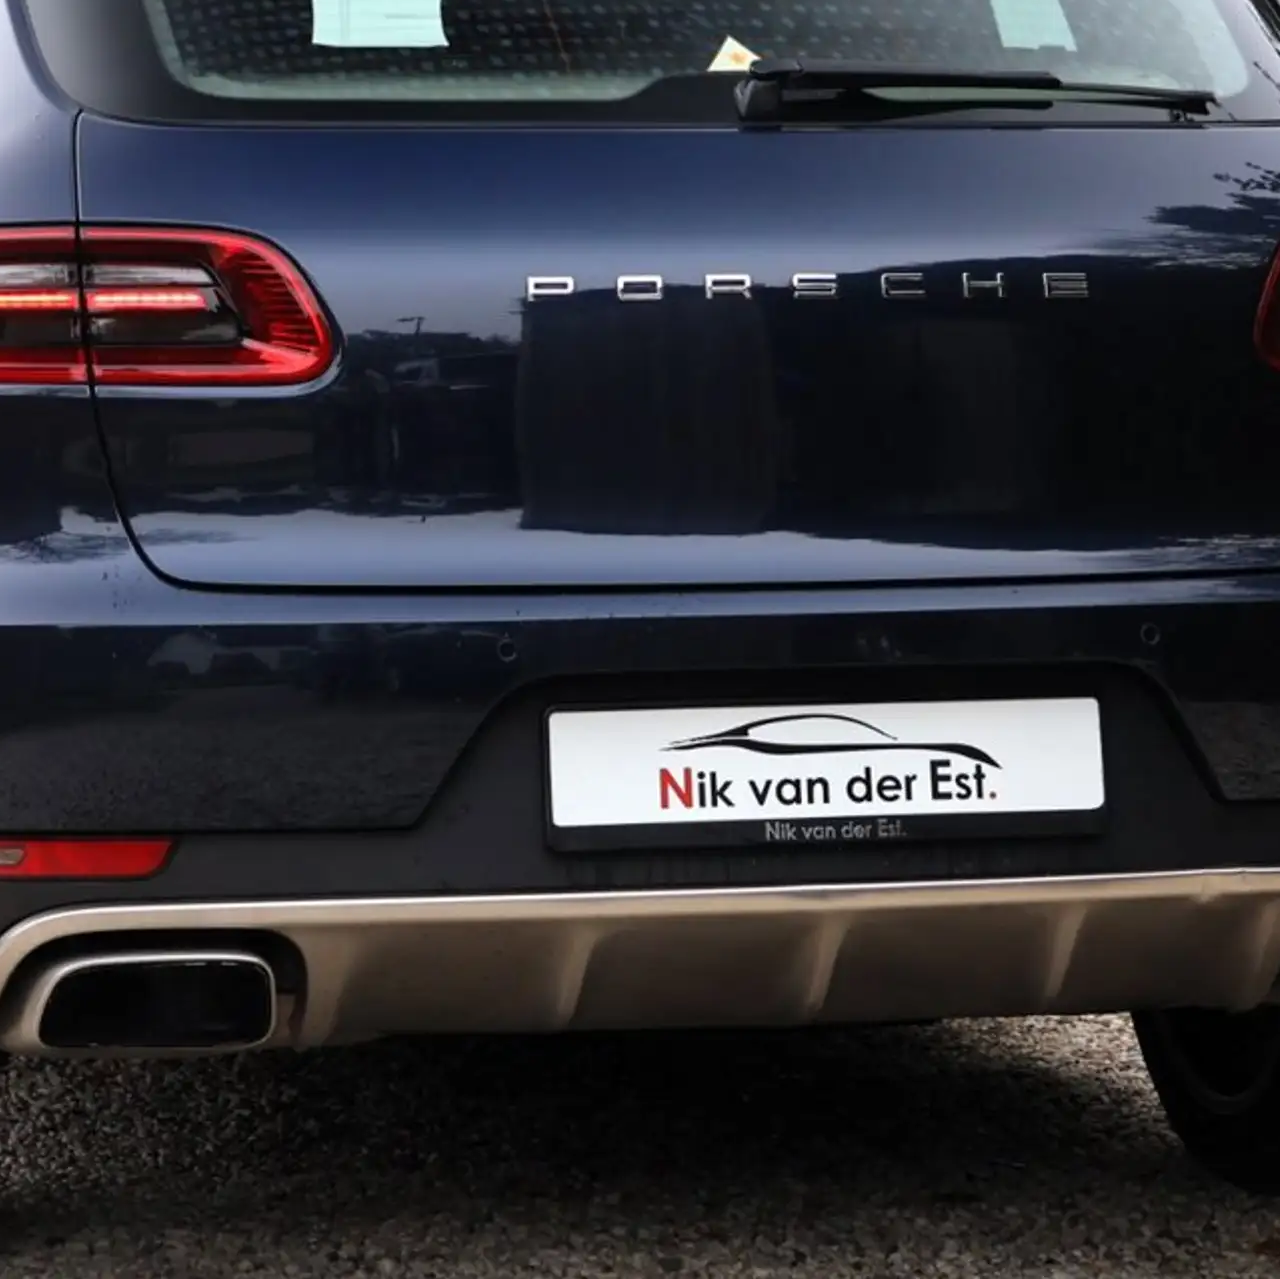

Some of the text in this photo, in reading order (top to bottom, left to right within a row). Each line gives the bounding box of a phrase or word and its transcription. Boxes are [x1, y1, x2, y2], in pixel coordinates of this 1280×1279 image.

[525, 271, 1090, 302] PORSCHE
[658, 759, 998, 810] Nik van der Est.
[764, 821, 797, 841] Nik
[801, 825, 837, 839] van
[840, 821, 872, 838] der
